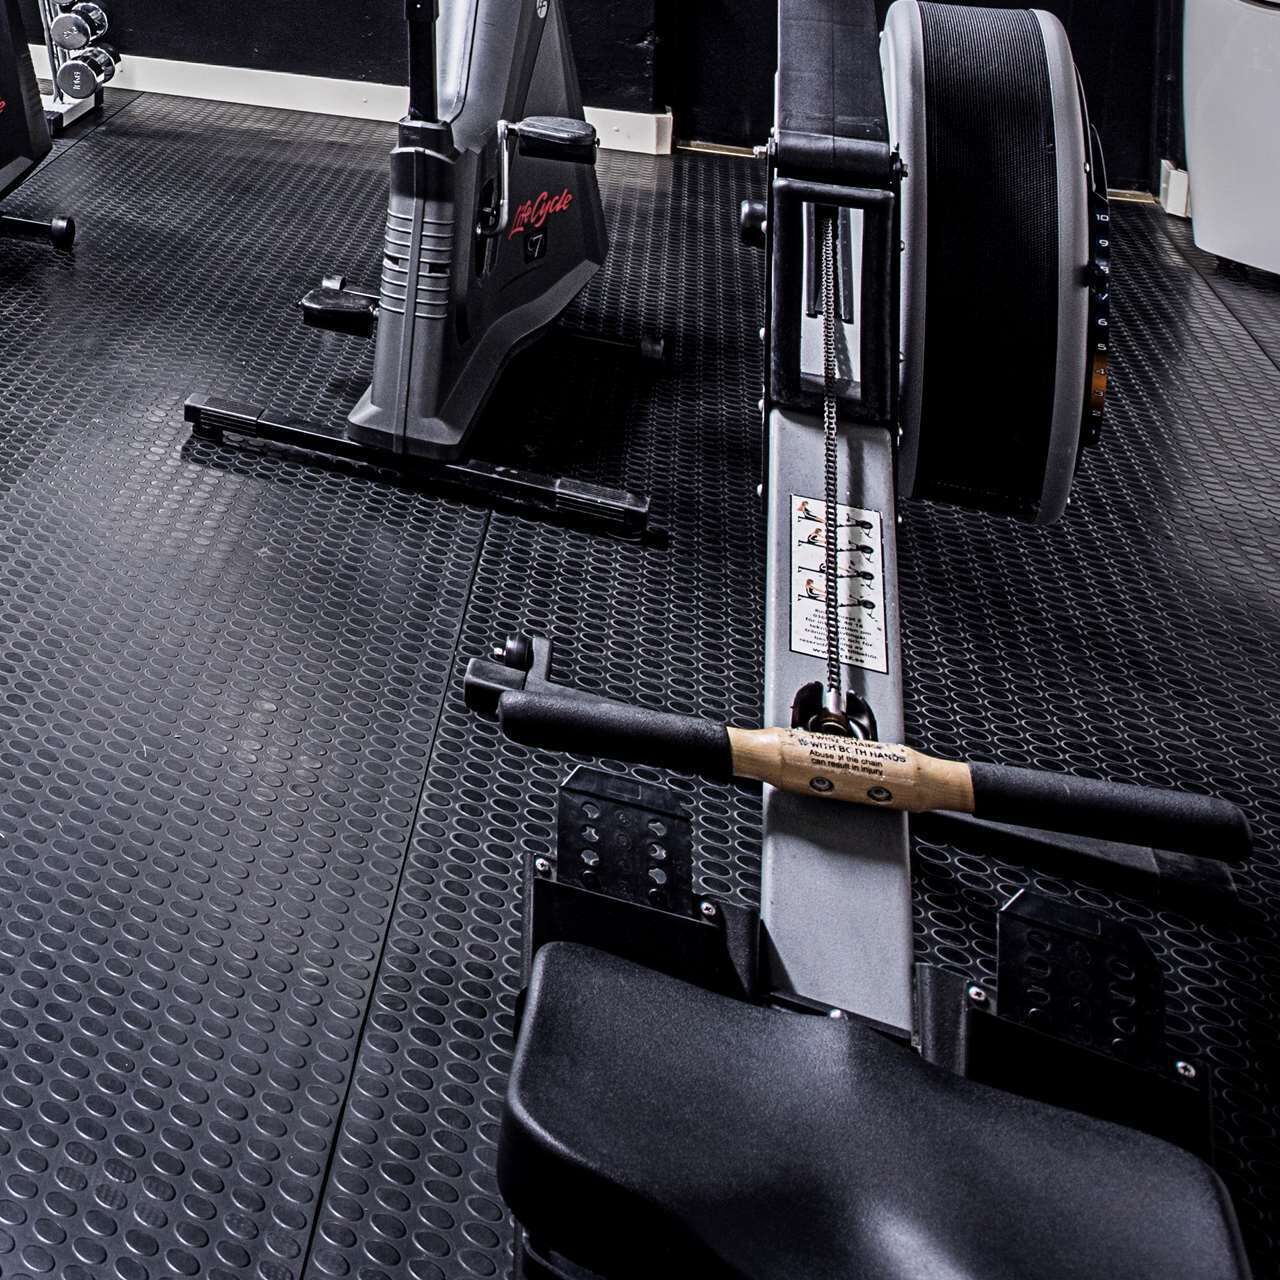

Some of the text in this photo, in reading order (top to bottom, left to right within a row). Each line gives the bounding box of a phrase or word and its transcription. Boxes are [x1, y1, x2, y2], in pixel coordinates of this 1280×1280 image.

[1096, 214, 1109, 222] 10
[1099, 239, 1109, 248] 9
[1098, 318, 1108, 326] 6
[1097, 343, 1107, 351] 5
[810, 741, 836, 751] WITH
[810, 757, 827, 767] can
[828, 759, 851, 770] result
[861, 765, 883, 776] injury
[861, 757, 883, 767] chain
